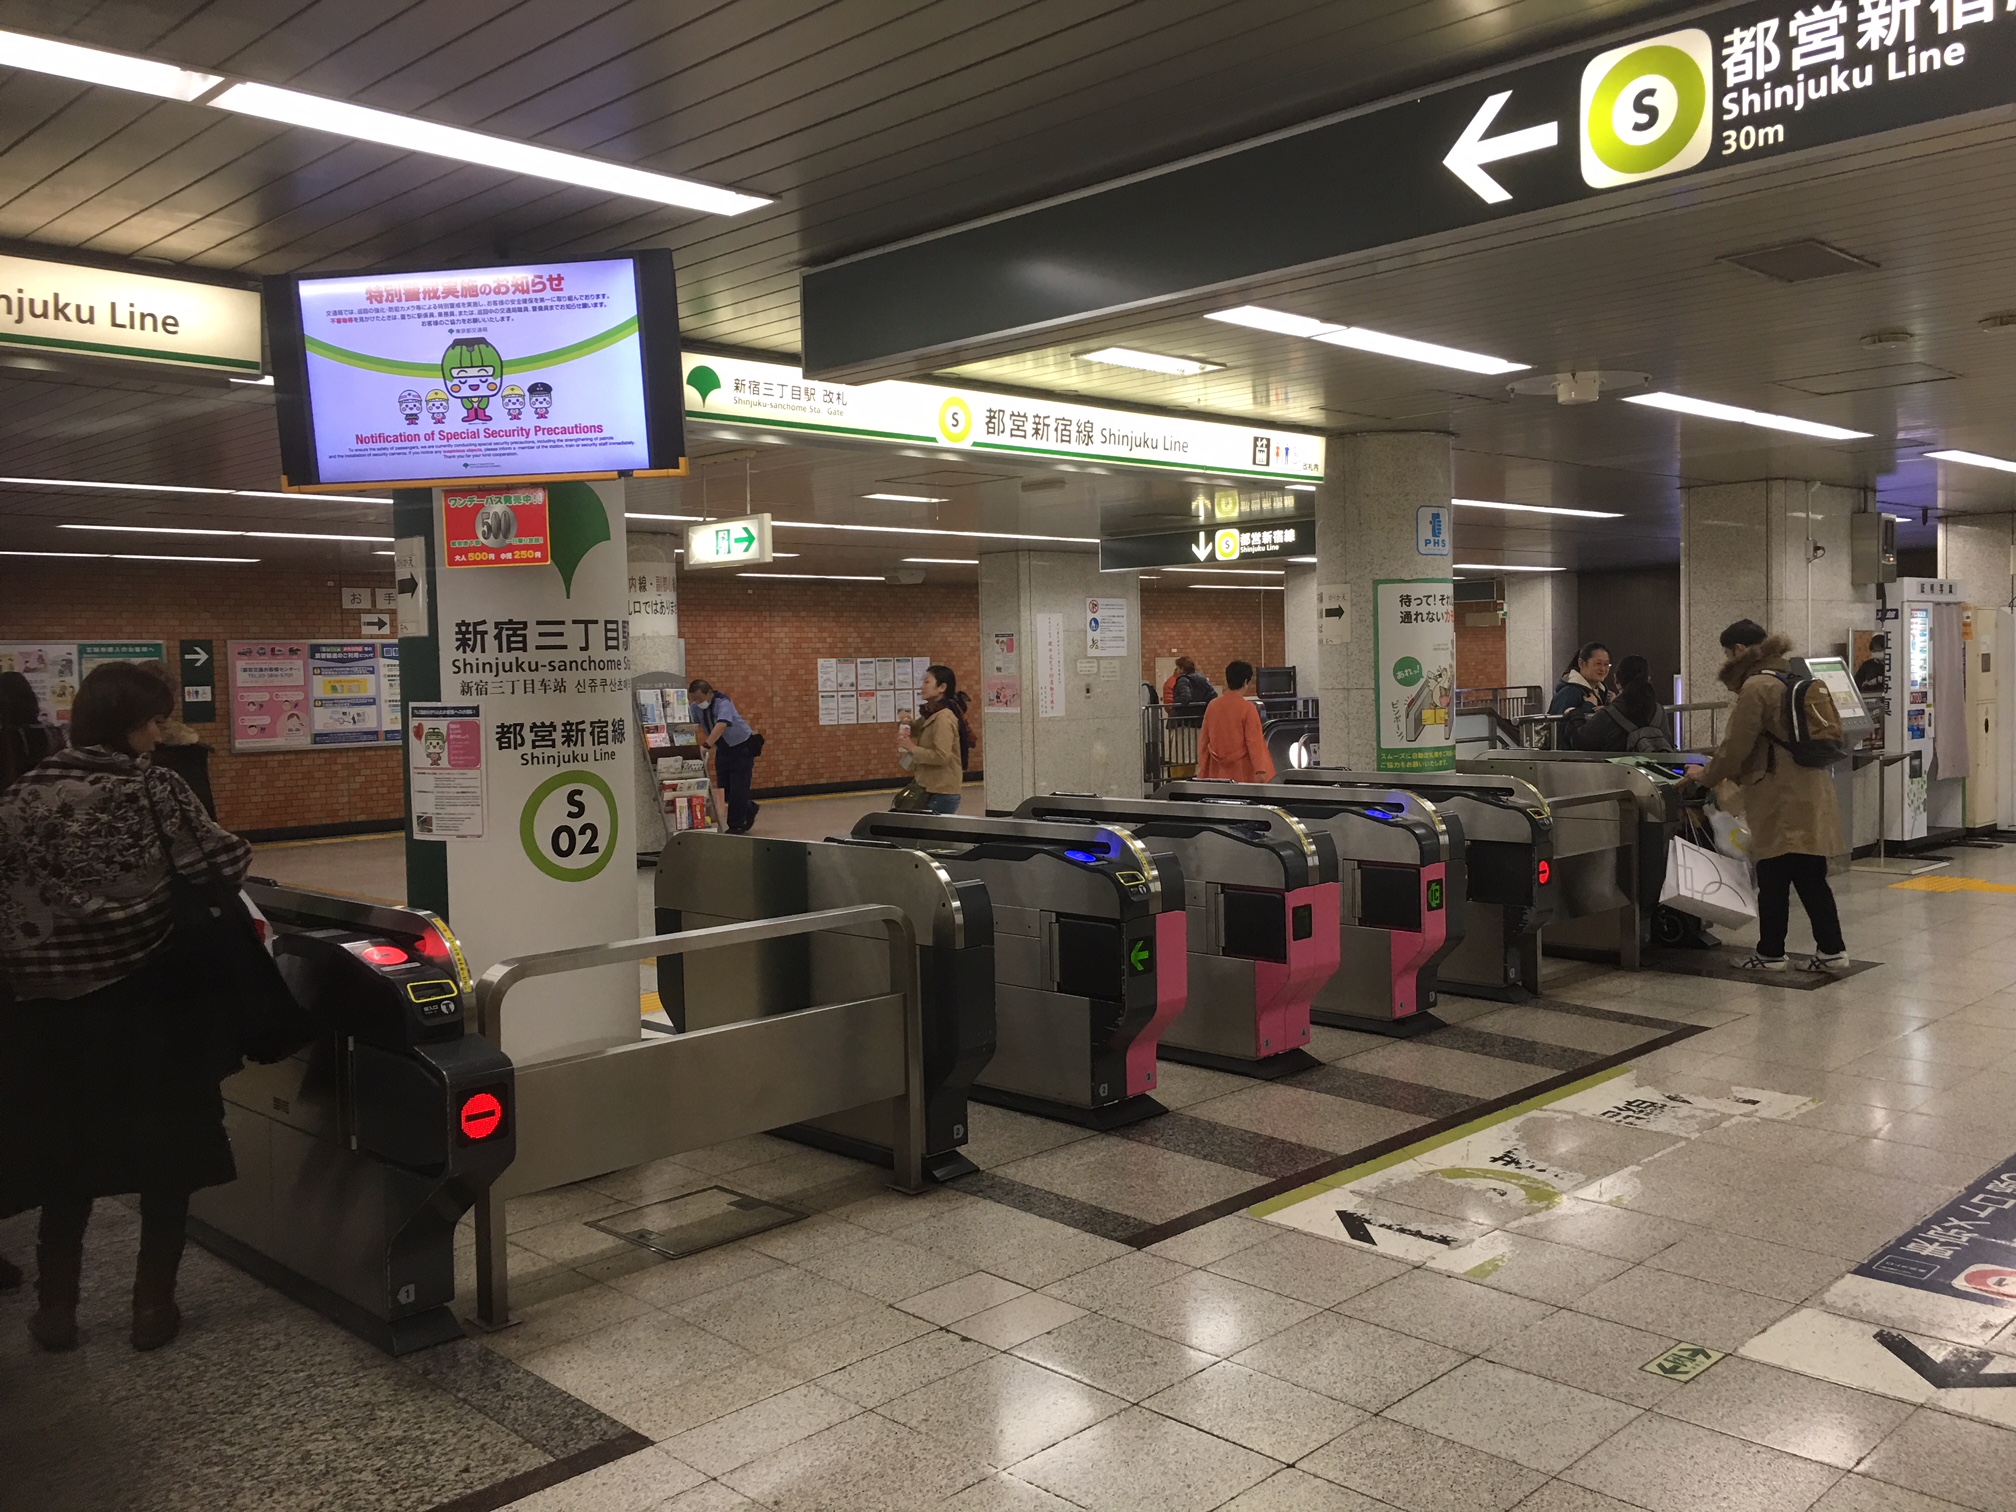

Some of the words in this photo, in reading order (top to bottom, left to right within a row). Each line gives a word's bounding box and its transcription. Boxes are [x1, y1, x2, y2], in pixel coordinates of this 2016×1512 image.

[1722, 63, 1873, 121] Shinjuku
[1887, 42, 1966, 81] Line
[1631, 88, 1660, 132] S
[1722, 123, 1785, 156] 30m
[365, 273, 565, 305] 特別警戒実施のお知らせ
[110, 301, 180, 335] Line
[421, 315, 515, 327] お客様のご協力をお願いいたします。
[733, 378, 816, 402] 新宿三丁目駅
[822, 389, 848, 406] 改札
[733, 396, 807, 413] Shinjuku-sanchome
[809, 405, 823, 414] Sta.
[827, 407, 844, 417] Gate
[951, 411, 959, 428] S
[985, 407, 1095, 446] 都営新宿線
[355, 431, 420, 445] Notification
[424, 430, 435, 442] of
[438, 428, 480, 443] Special
[483, 426, 531, 439] Security
[534, 423, 603, 437] Precautions
[537, 438, 557, 446] including
[564, 437, 593, 445] strengthening
[1100, 427, 1159, 451] Shinjuku
[1163, 435, 1189, 453] Line
[581, 441, 597, 449] security
[480, 510, 511, 540] 500
[1224, 540, 1231, 549] S
[1240, 528, 1296, 547] 都営新宿線
[1424, 538, 1447, 548] PHS
[1240, 545, 1266, 554] Shinjuku
[1266, 544, 1280, 552] Line
[350, 592, 362, 605] お
[383, 592, 396, 605] 手
[452, 655, 622, 678] Shinjuku-sanchome
[1396, 664, 1420, 679] あれっ!
[459, 677, 567, 697] 新宿三丁目车站
[495, 717, 626, 751] 都営新宿線
[520, 750, 589, 767] Shinjuku
[593, 748, 616, 762] Line
[566, 789, 586, 819] S
[551, 822, 600, 858] 02
[1430, 887, 1439, 902] IC
